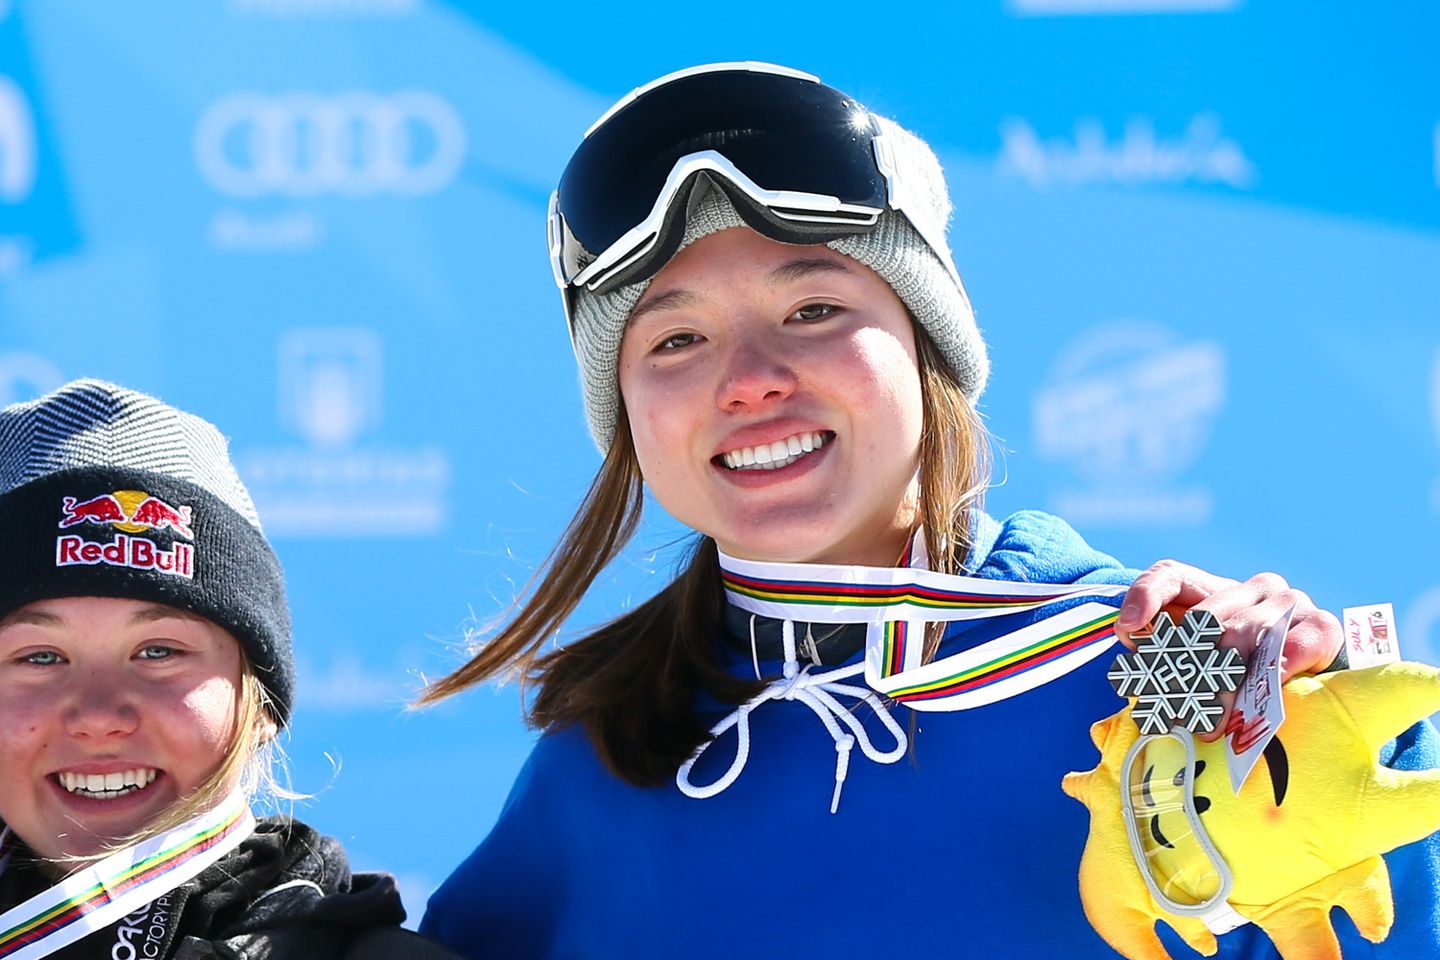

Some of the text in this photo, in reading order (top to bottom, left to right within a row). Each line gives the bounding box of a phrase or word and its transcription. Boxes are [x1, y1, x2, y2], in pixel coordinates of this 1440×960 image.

[57, 534, 194, 579] Red Bull
[1154, 652, 1197, 693] FIS
